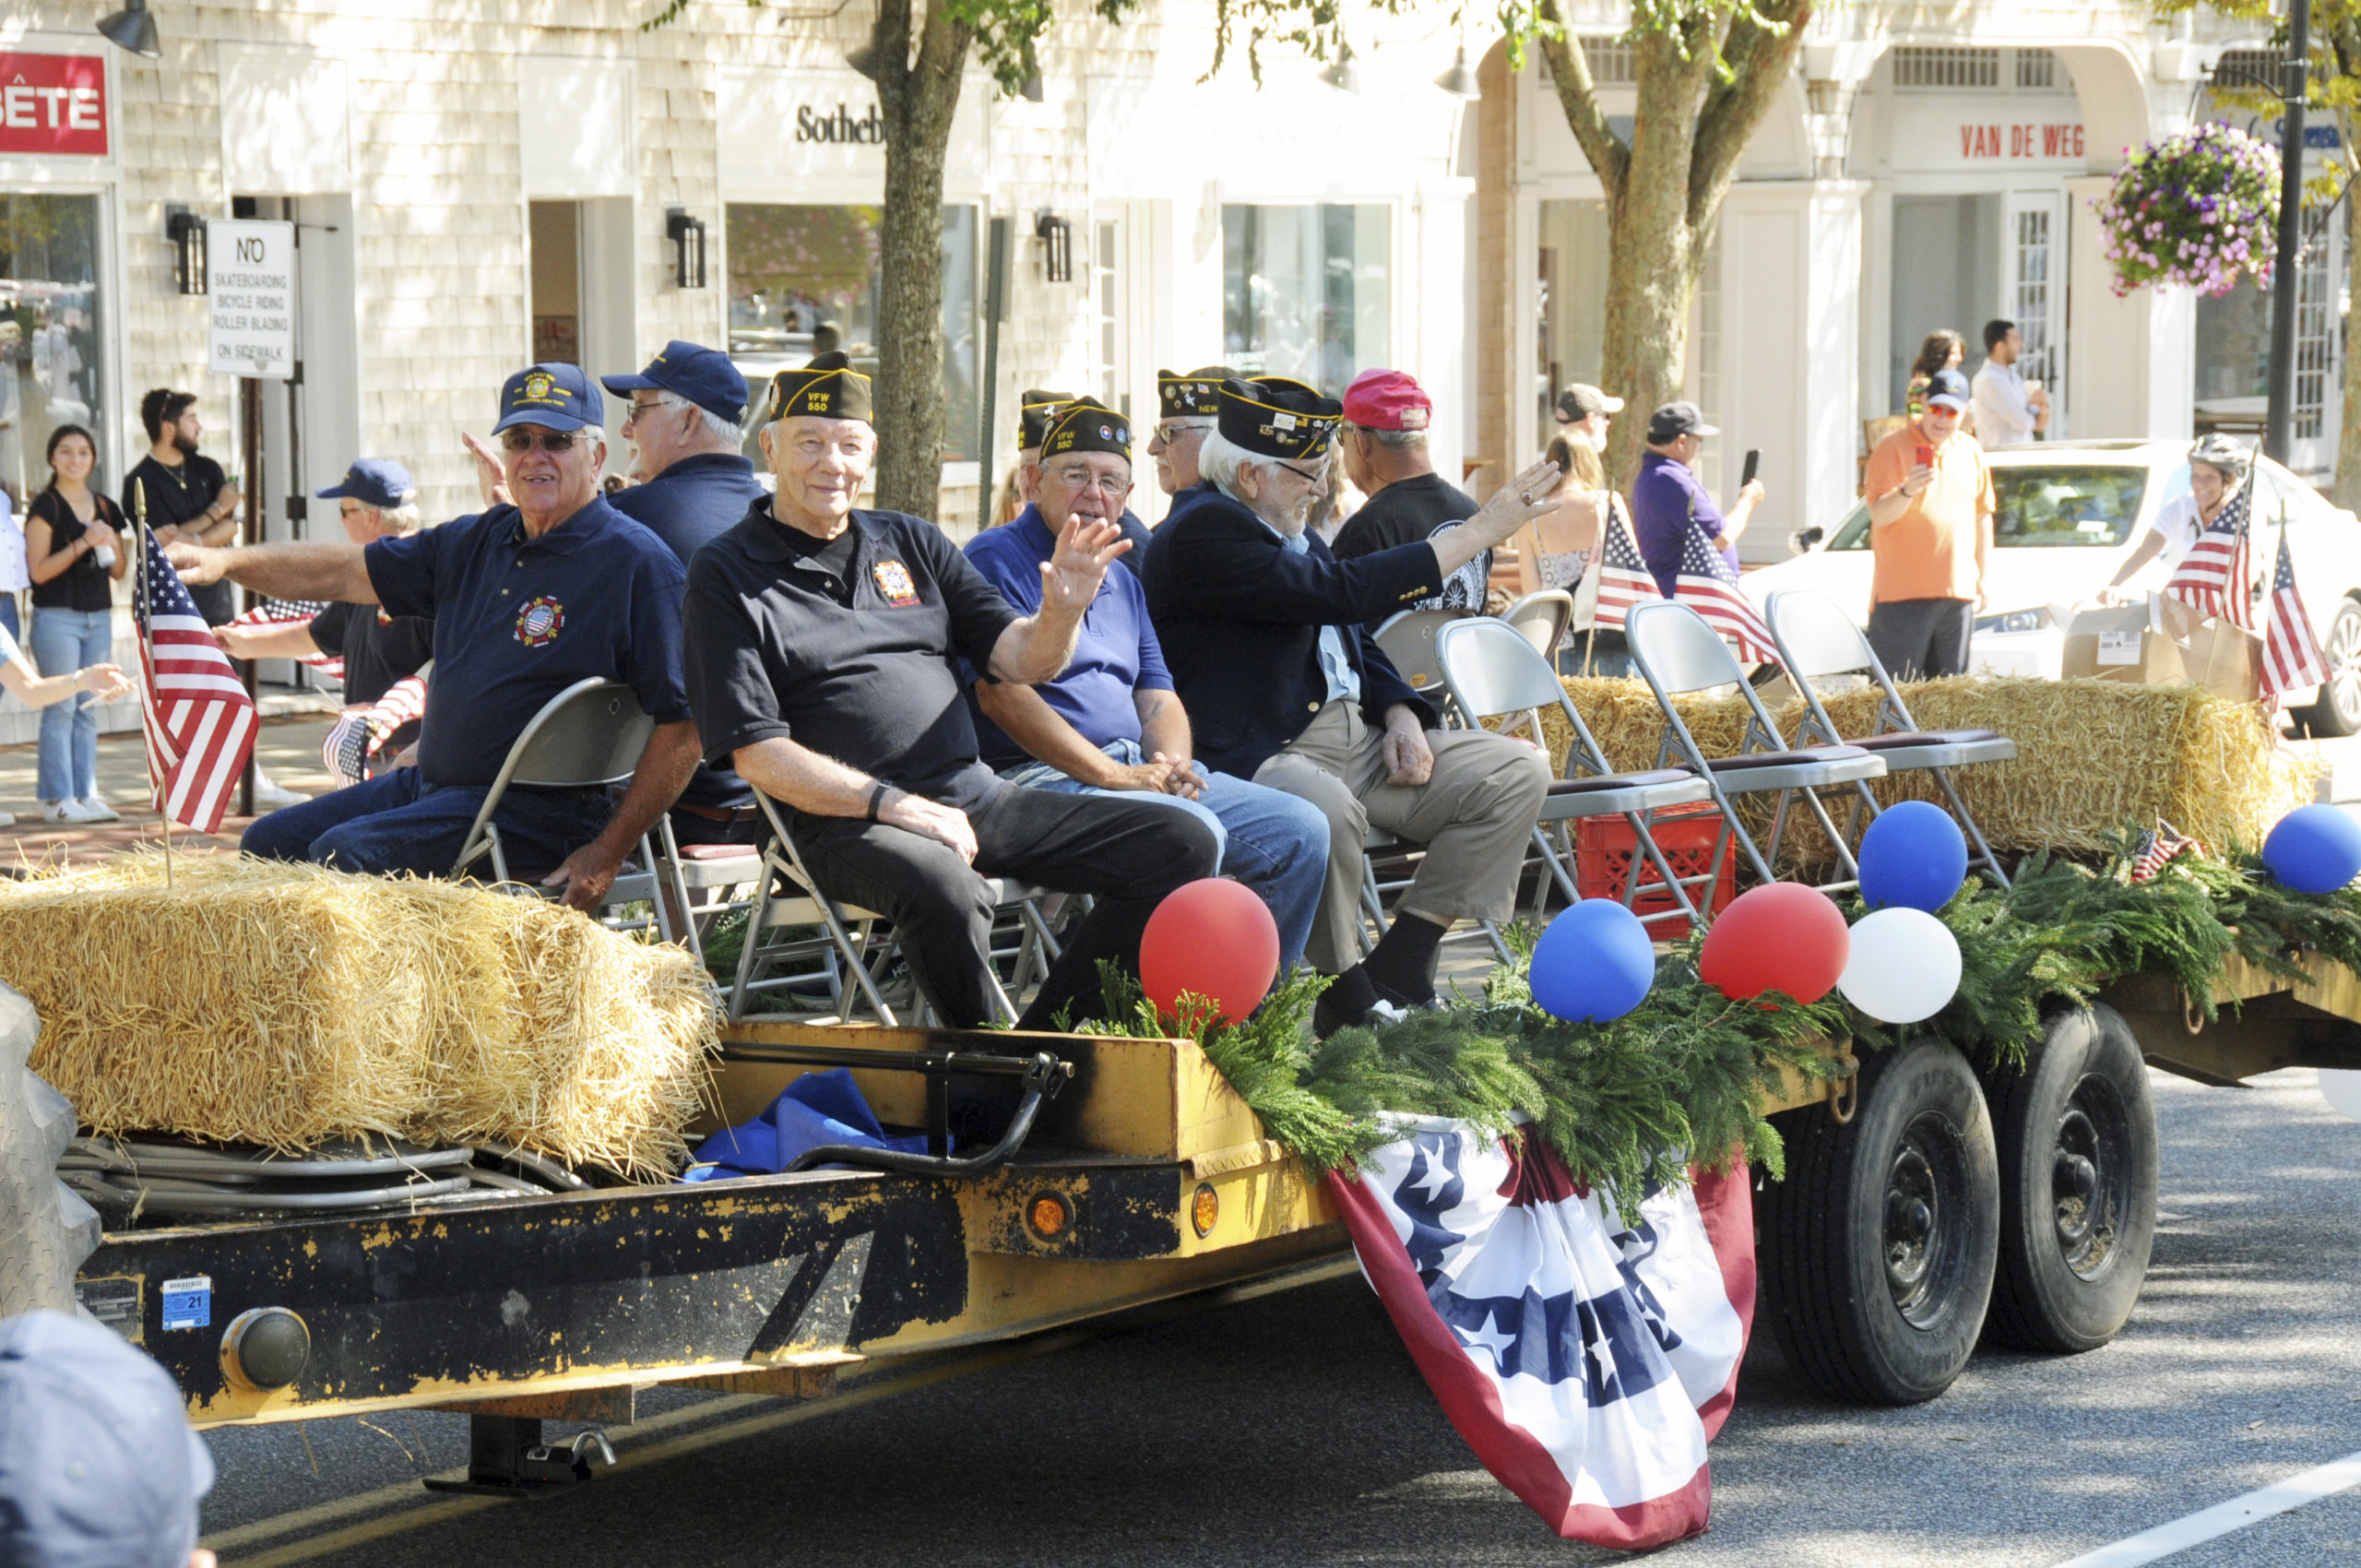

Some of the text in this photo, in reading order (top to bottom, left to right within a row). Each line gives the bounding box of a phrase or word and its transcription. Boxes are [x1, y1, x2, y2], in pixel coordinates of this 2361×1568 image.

[0, 73, 101, 130] ÊTE
[796, 102, 886, 145] Sotheb
[1961, 124, 2084, 159] VAN DE WEG
[236, 237, 265, 264] NO
[214, 273, 288, 289] SKATEBOARDING
[217, 294, 284, 310] BICYCLE RIDING
[213, 315, 288, 331] ROLLER BLADING
[218, 343, 282, 361] ON SIDEWALK
[807, 392, 830, 402] VFW
[807, 402, 827, 412] 550
[1199, 405, 1217, 413] NEW
[1057, 431, 1076, 441] VFW
[188, 1296, 202, 1309] 21
